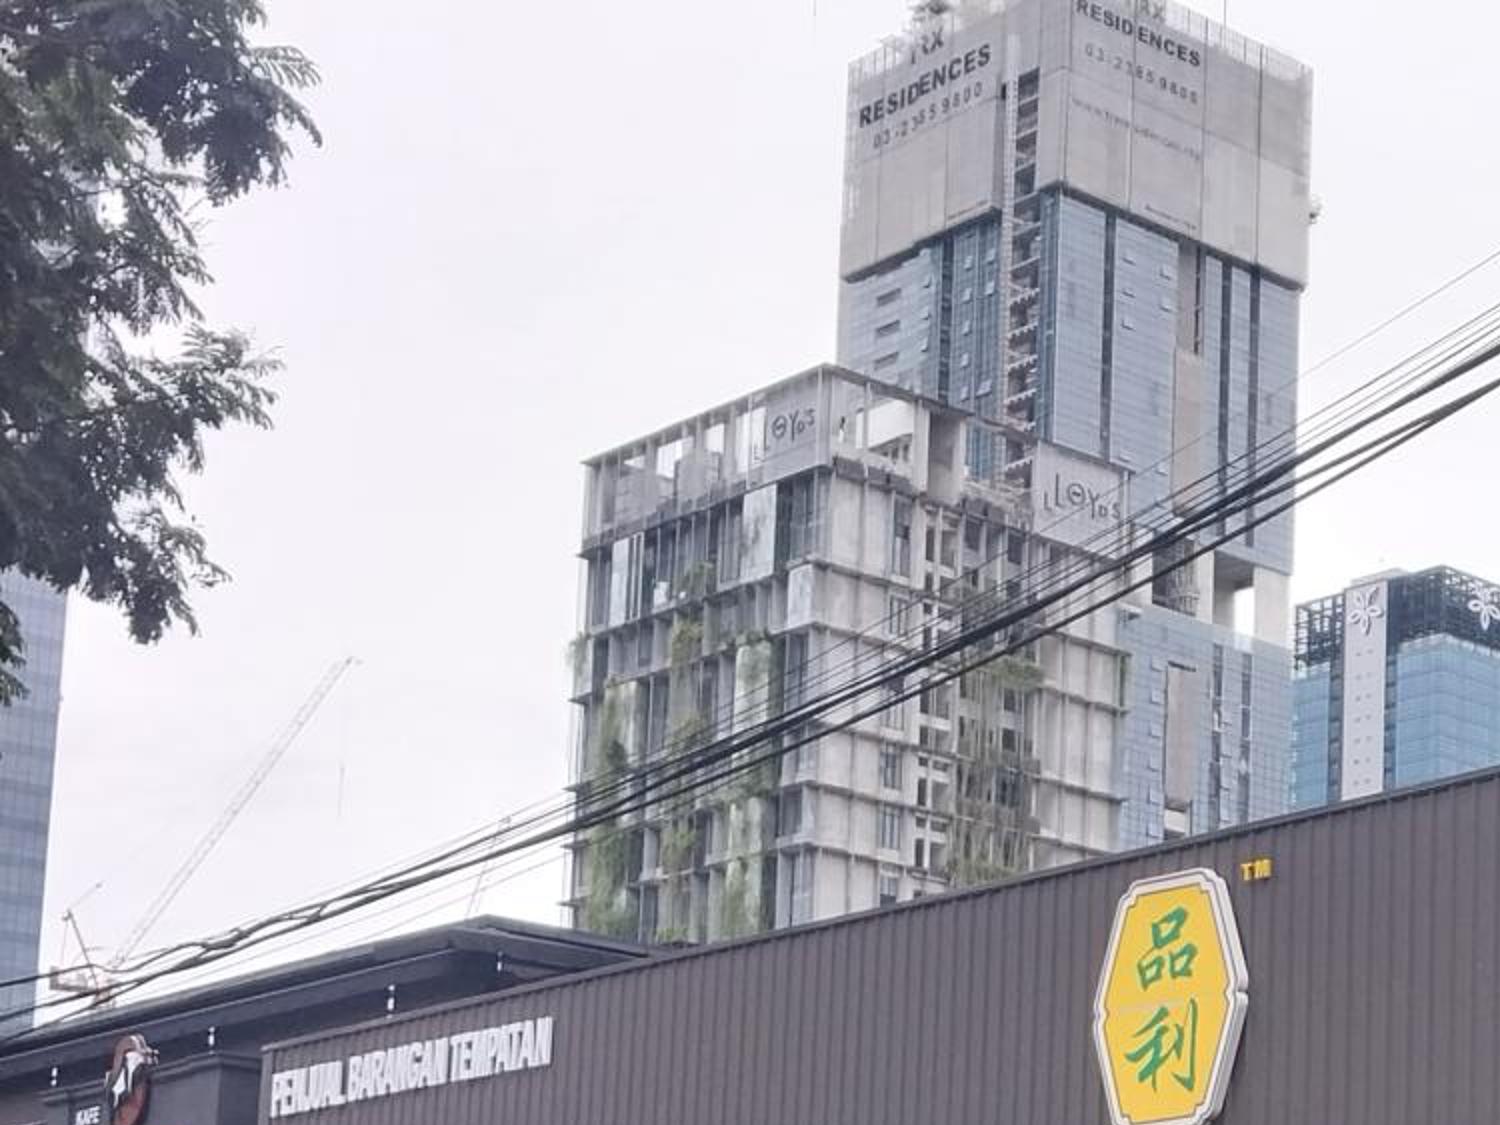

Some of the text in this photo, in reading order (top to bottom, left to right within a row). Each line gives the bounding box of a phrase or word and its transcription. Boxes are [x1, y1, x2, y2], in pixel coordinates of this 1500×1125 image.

[1076, 0, 1200, 67] RESIDENCES
[859, 43, 991, 128] RESIDENCES
[1125, 906, 1199, 1092] 品利
[347, 1037, 449, 1102] BARANGAN
[450, 1016, 553, 1083] TEMPATAN
